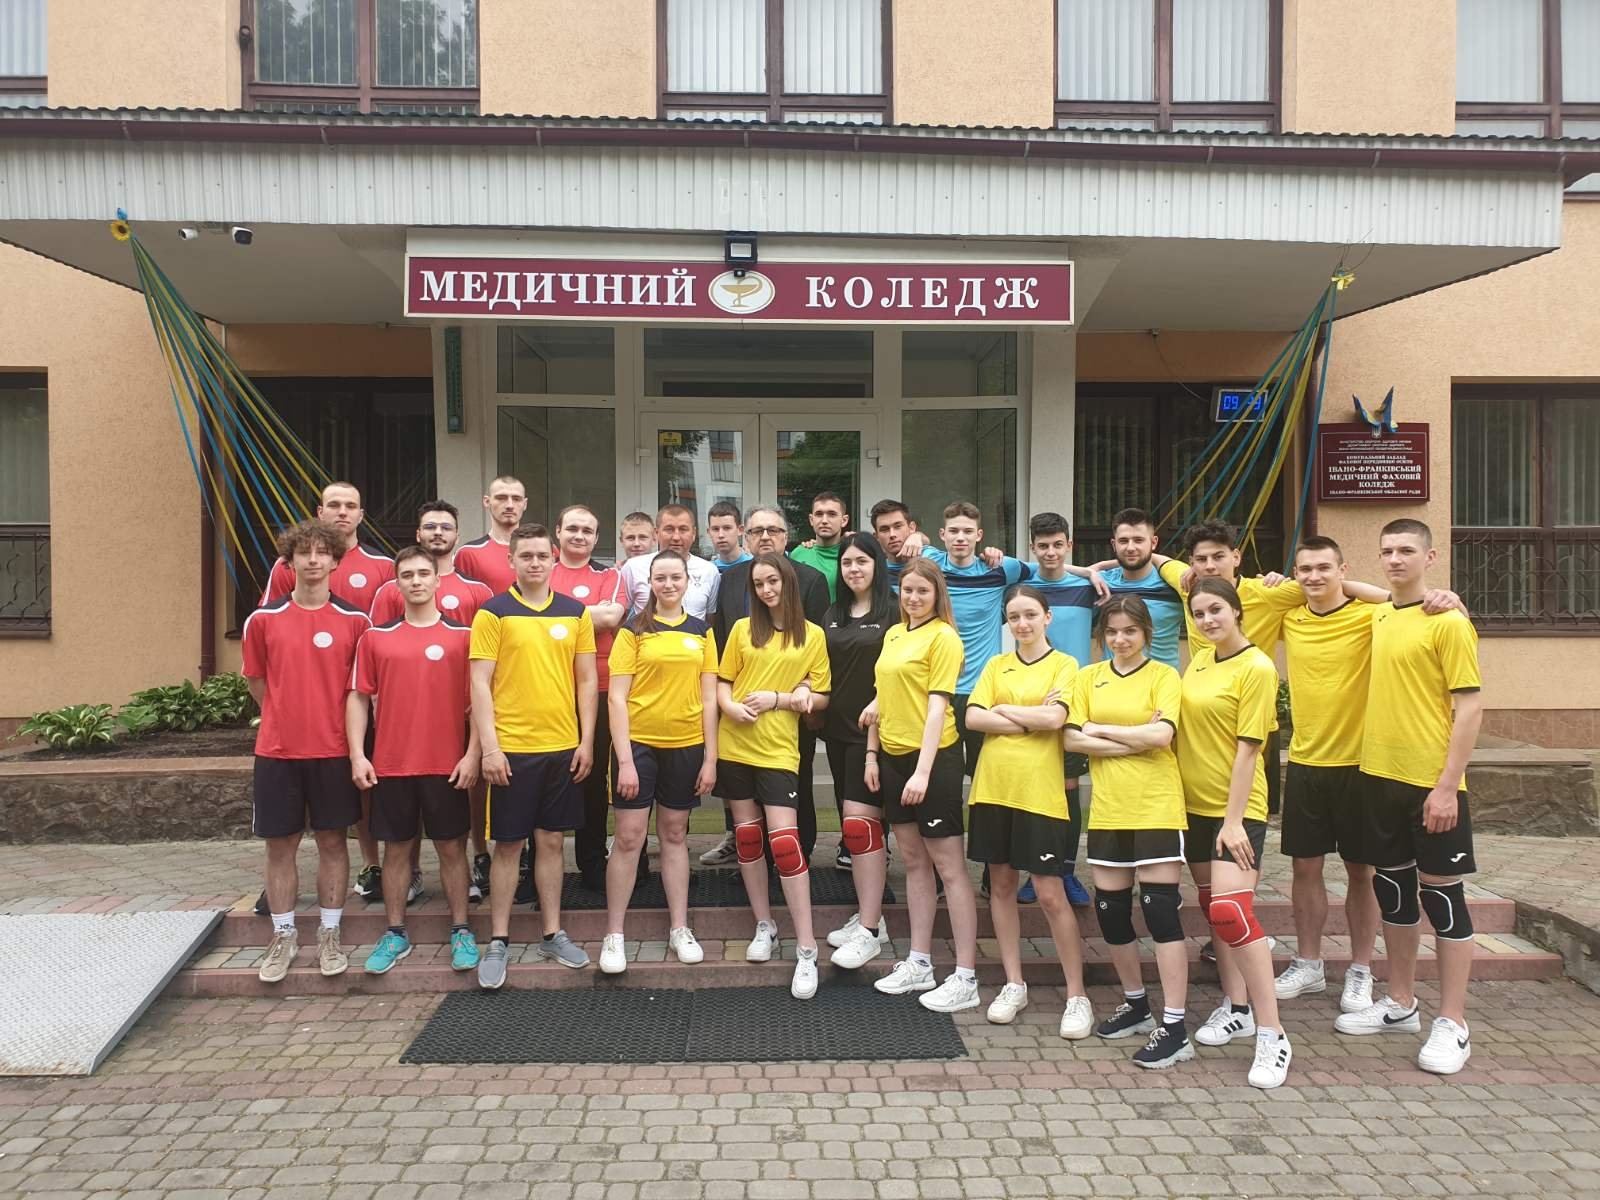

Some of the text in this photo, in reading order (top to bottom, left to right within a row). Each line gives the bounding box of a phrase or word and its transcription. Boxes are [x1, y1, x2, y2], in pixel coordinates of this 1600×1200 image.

[419, 267, 1040, 316] МЕДИЧНИЙ КОЛЕДЖ
[1328, 465, 1422, 473] ІВАНО-ФРАНКІВСЬКИЙ
[1329, 472, 1422, 481] МЕДИЧНИЙ ФАХОВИЙ
